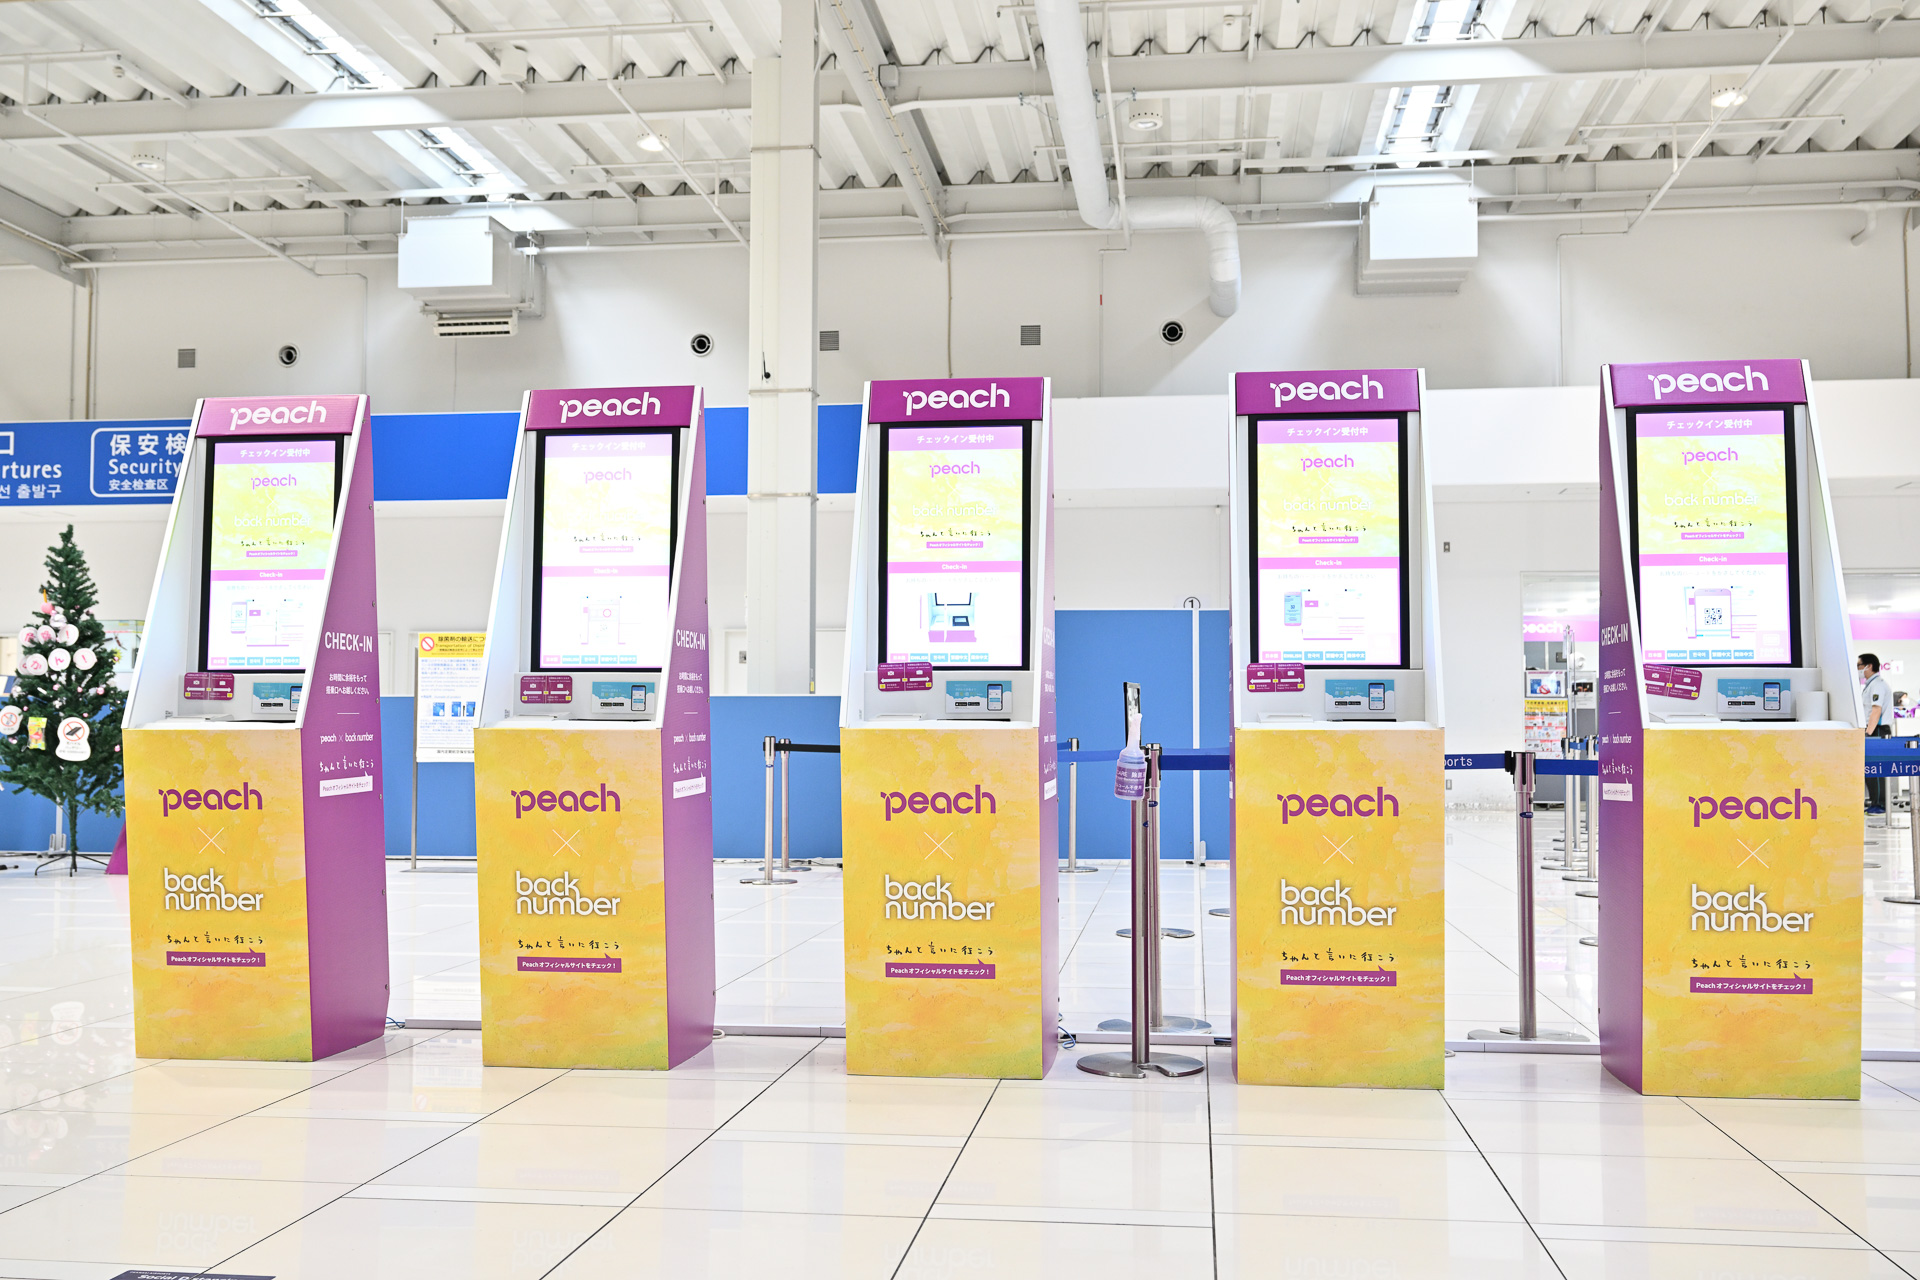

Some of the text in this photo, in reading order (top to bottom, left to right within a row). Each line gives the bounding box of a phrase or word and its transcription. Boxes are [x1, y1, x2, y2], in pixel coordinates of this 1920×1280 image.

[1270, 375, 1383, 408] peach
[1648, 366, 1769, 400] peach
[559, 392, 660, 424] peach
[903, 383, 1010, 416] peach
[230, 400, 326, 430] peach
[1667, 419, 1752, 430] チェックイン受付中
[916, 434, 994, 444] チェックイン受付中
[1287, 427, 1368, 436] チェックイン受付中
[1301, 454, 1354, 472] peach
[1682, 448, 1738, 465] peach
[2, 461, 62, 479] rtures
[108, 458, 182, 478] Security
[584, 468, 632, 484] peach
[930, 461, 980, 478] peach
[16, 484, 62, 499] 출발구
[251, 474, 296, 490] peach
[1284, 499, 1316, 511] back
[1665, 492, 1758, 506] back number
[325, 632, 372, 652] CHECK-IN
[676, 629, 706, 650] CHECK-IN
[1602, 623, 1628, 646] CHECK-IN
[1890, 762, 1920, 774] Airp
[158, 782, 262, 817] peach
[511, 783, 620, 818] peach
[880, 784, 996, 821] peach
[1277, 786, 1398, 824] peach
[1689, 788, 1818, 827] peach
[164, 868, 224, 892] back
[516, 870, 580, 896] back
[885, 874, 952, 900] back
[165, 892, 264, 911] number
[1281, 878, 1352, 905] back
[1692, 884, 1768, 910] back
[517, 896, 620, 916] number
[886, 900, 994, 920] number
[1281, 906, 1396, 926] number
[1692, 912, 1814, 932] number
